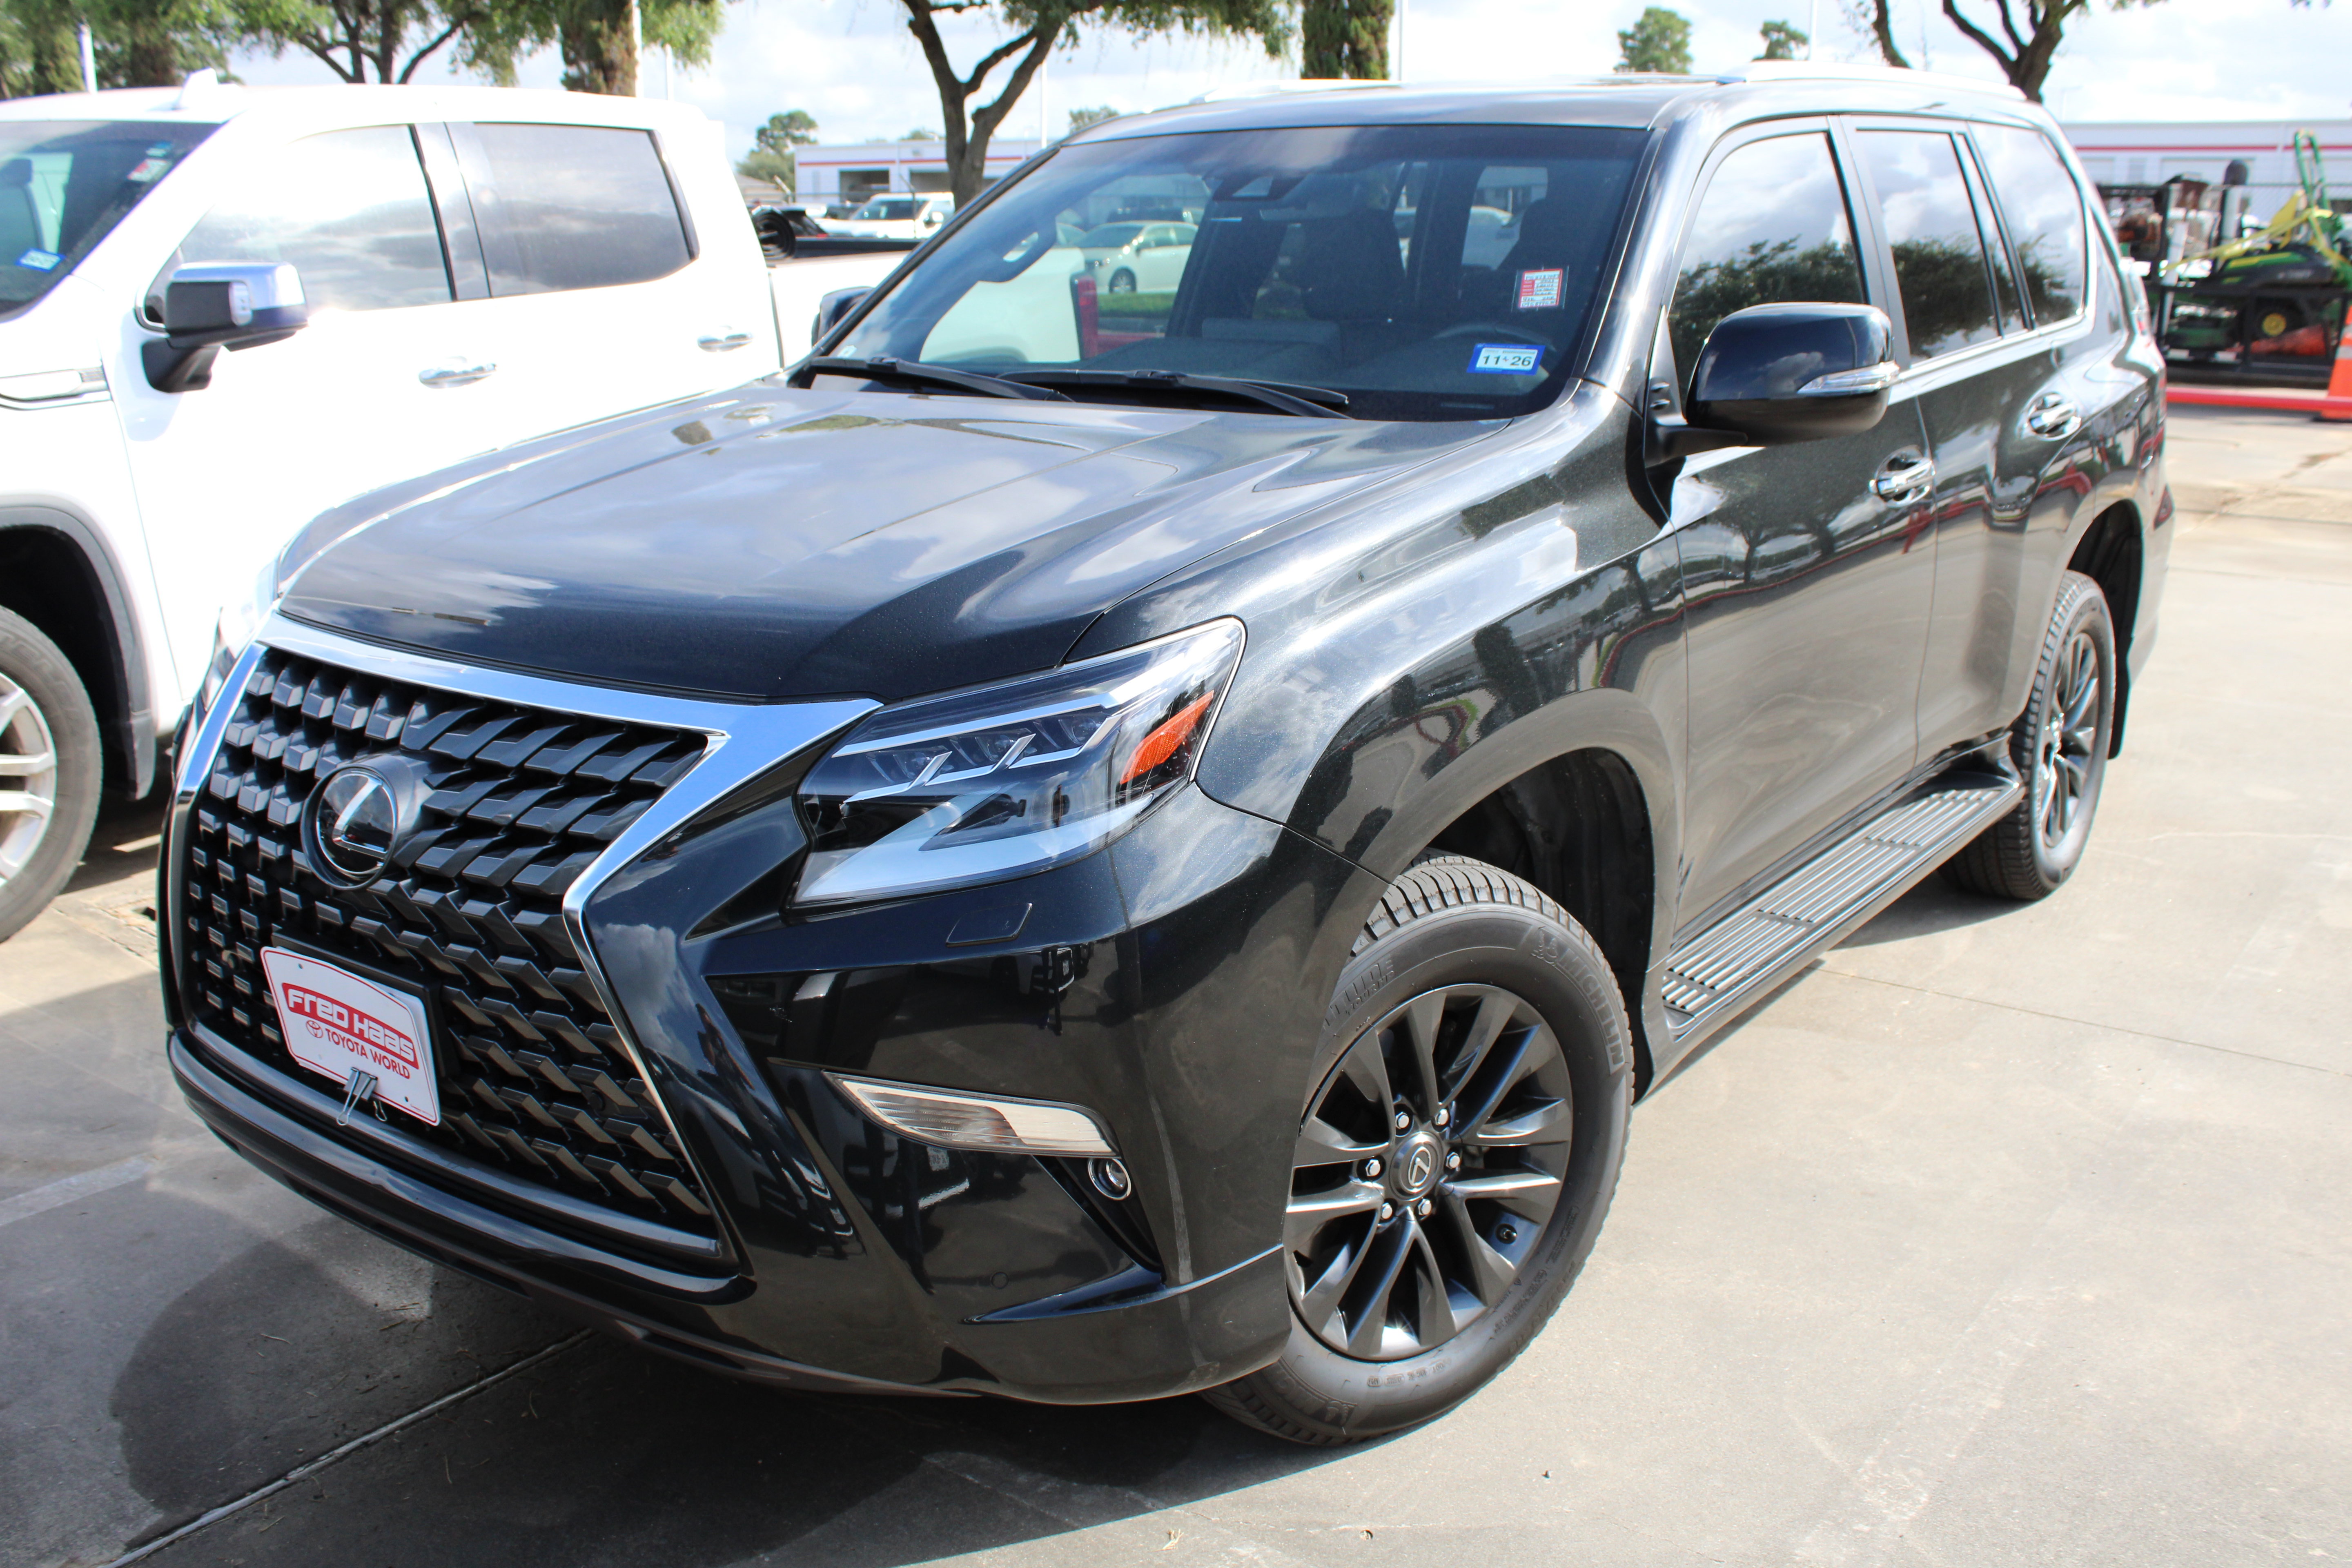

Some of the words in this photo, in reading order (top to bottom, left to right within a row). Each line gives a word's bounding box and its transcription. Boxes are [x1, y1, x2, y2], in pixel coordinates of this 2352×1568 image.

[1483, 355, 1501, 365] 11
[1510, 355, 1532, 366] 26
[1558, 948, 1626, 1065] MICHELIN
[325, 1028, 369, 1059] TOYOTA
[370, 1048, 410, 1079] WORLD
